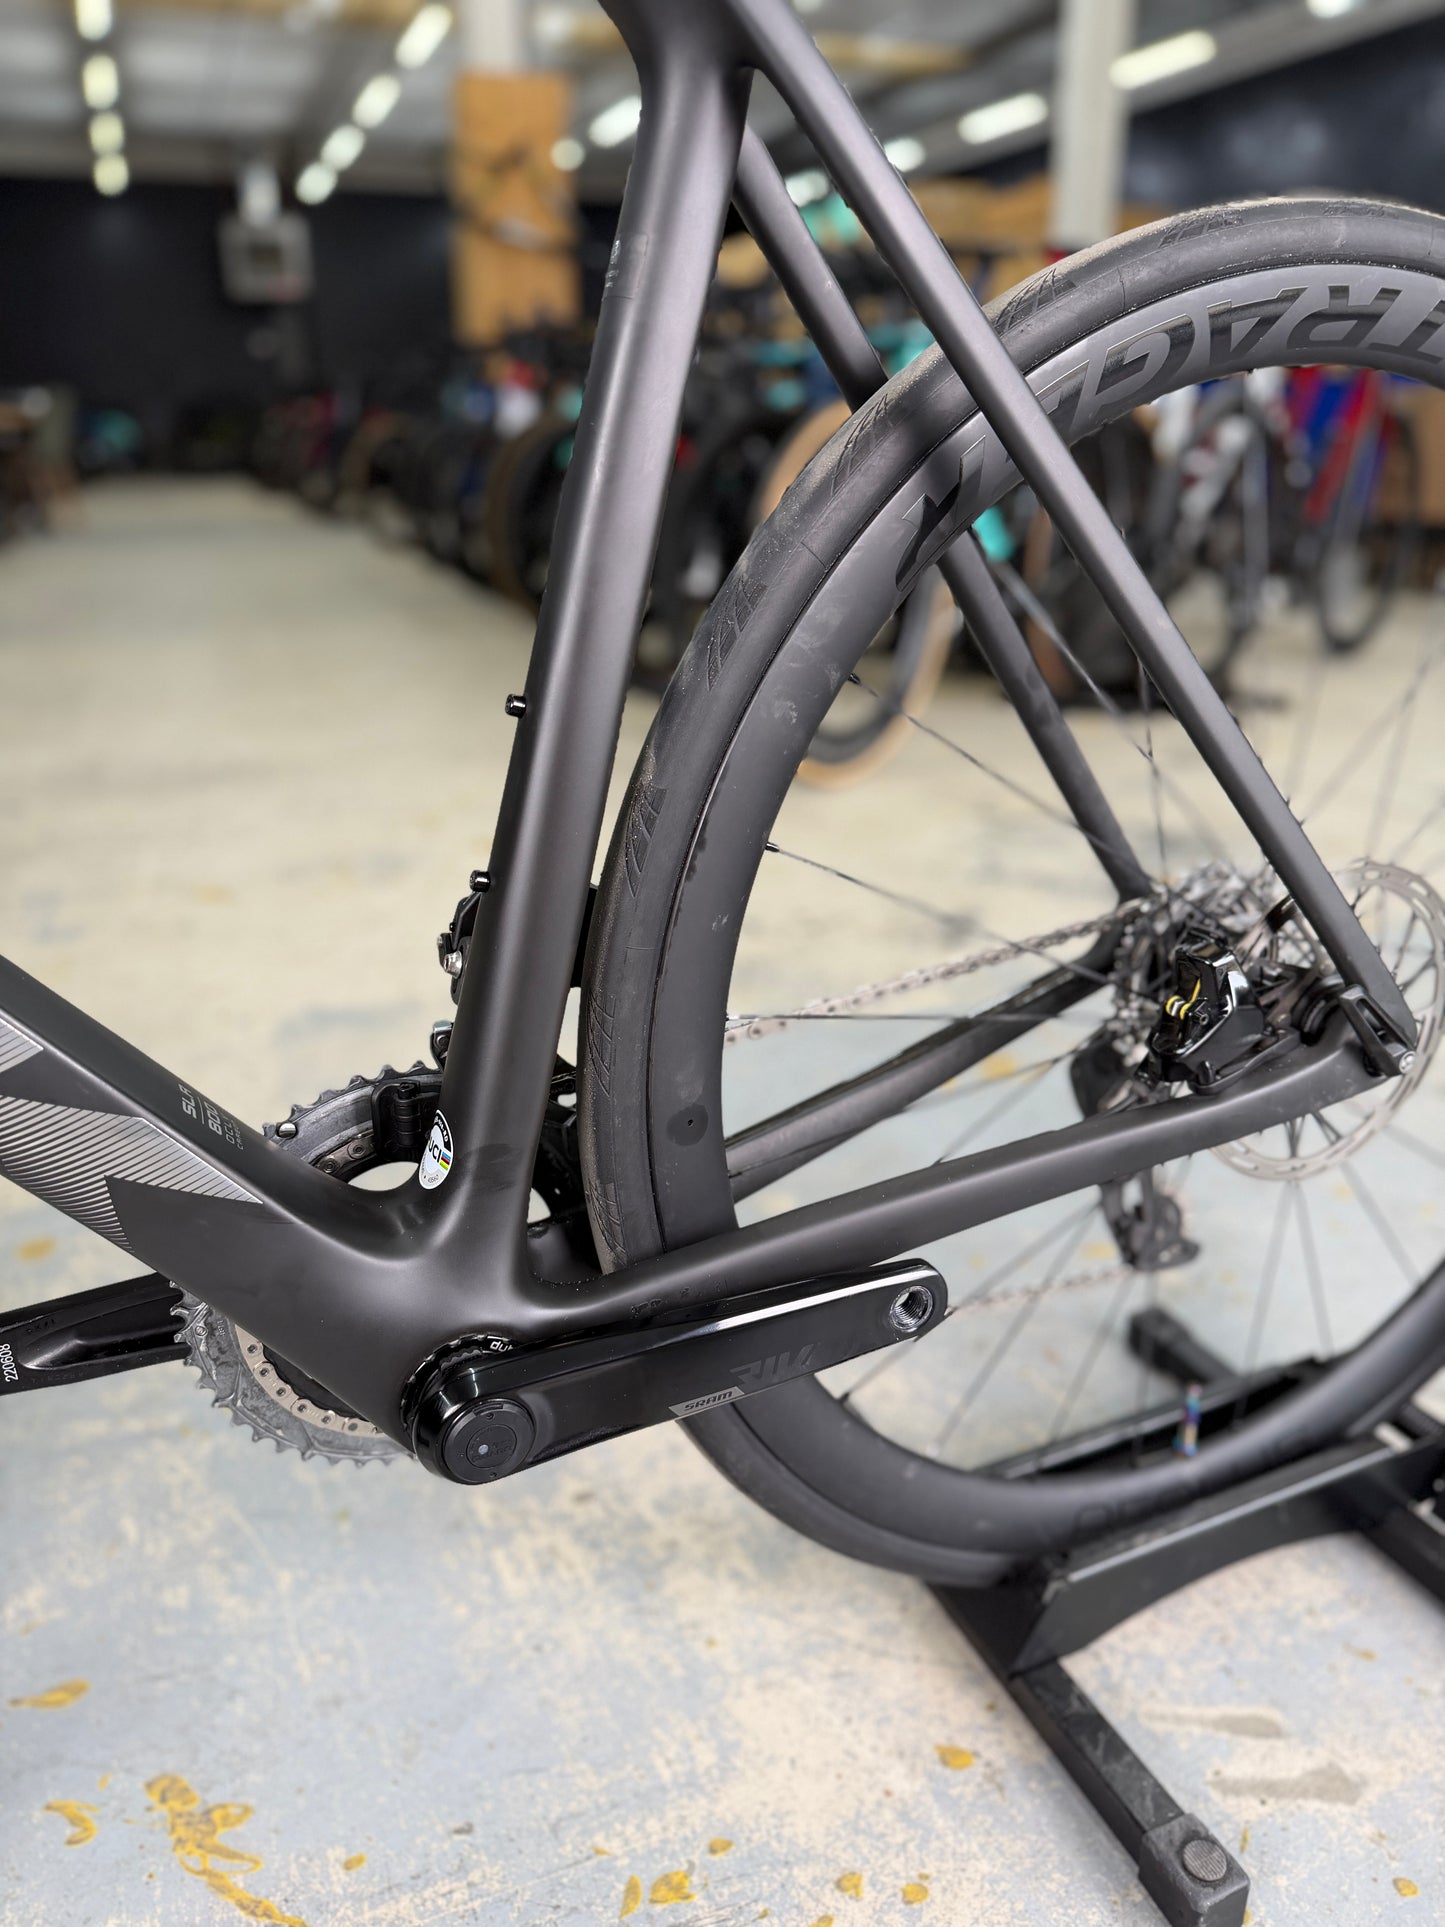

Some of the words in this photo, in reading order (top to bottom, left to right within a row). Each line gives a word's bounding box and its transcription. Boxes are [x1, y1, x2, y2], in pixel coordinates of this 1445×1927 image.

[203, 1100, 223, 1136] 800
[0, 1343, 19, 1383] 220608
[684, 1391, 733, 1412] SRAM
